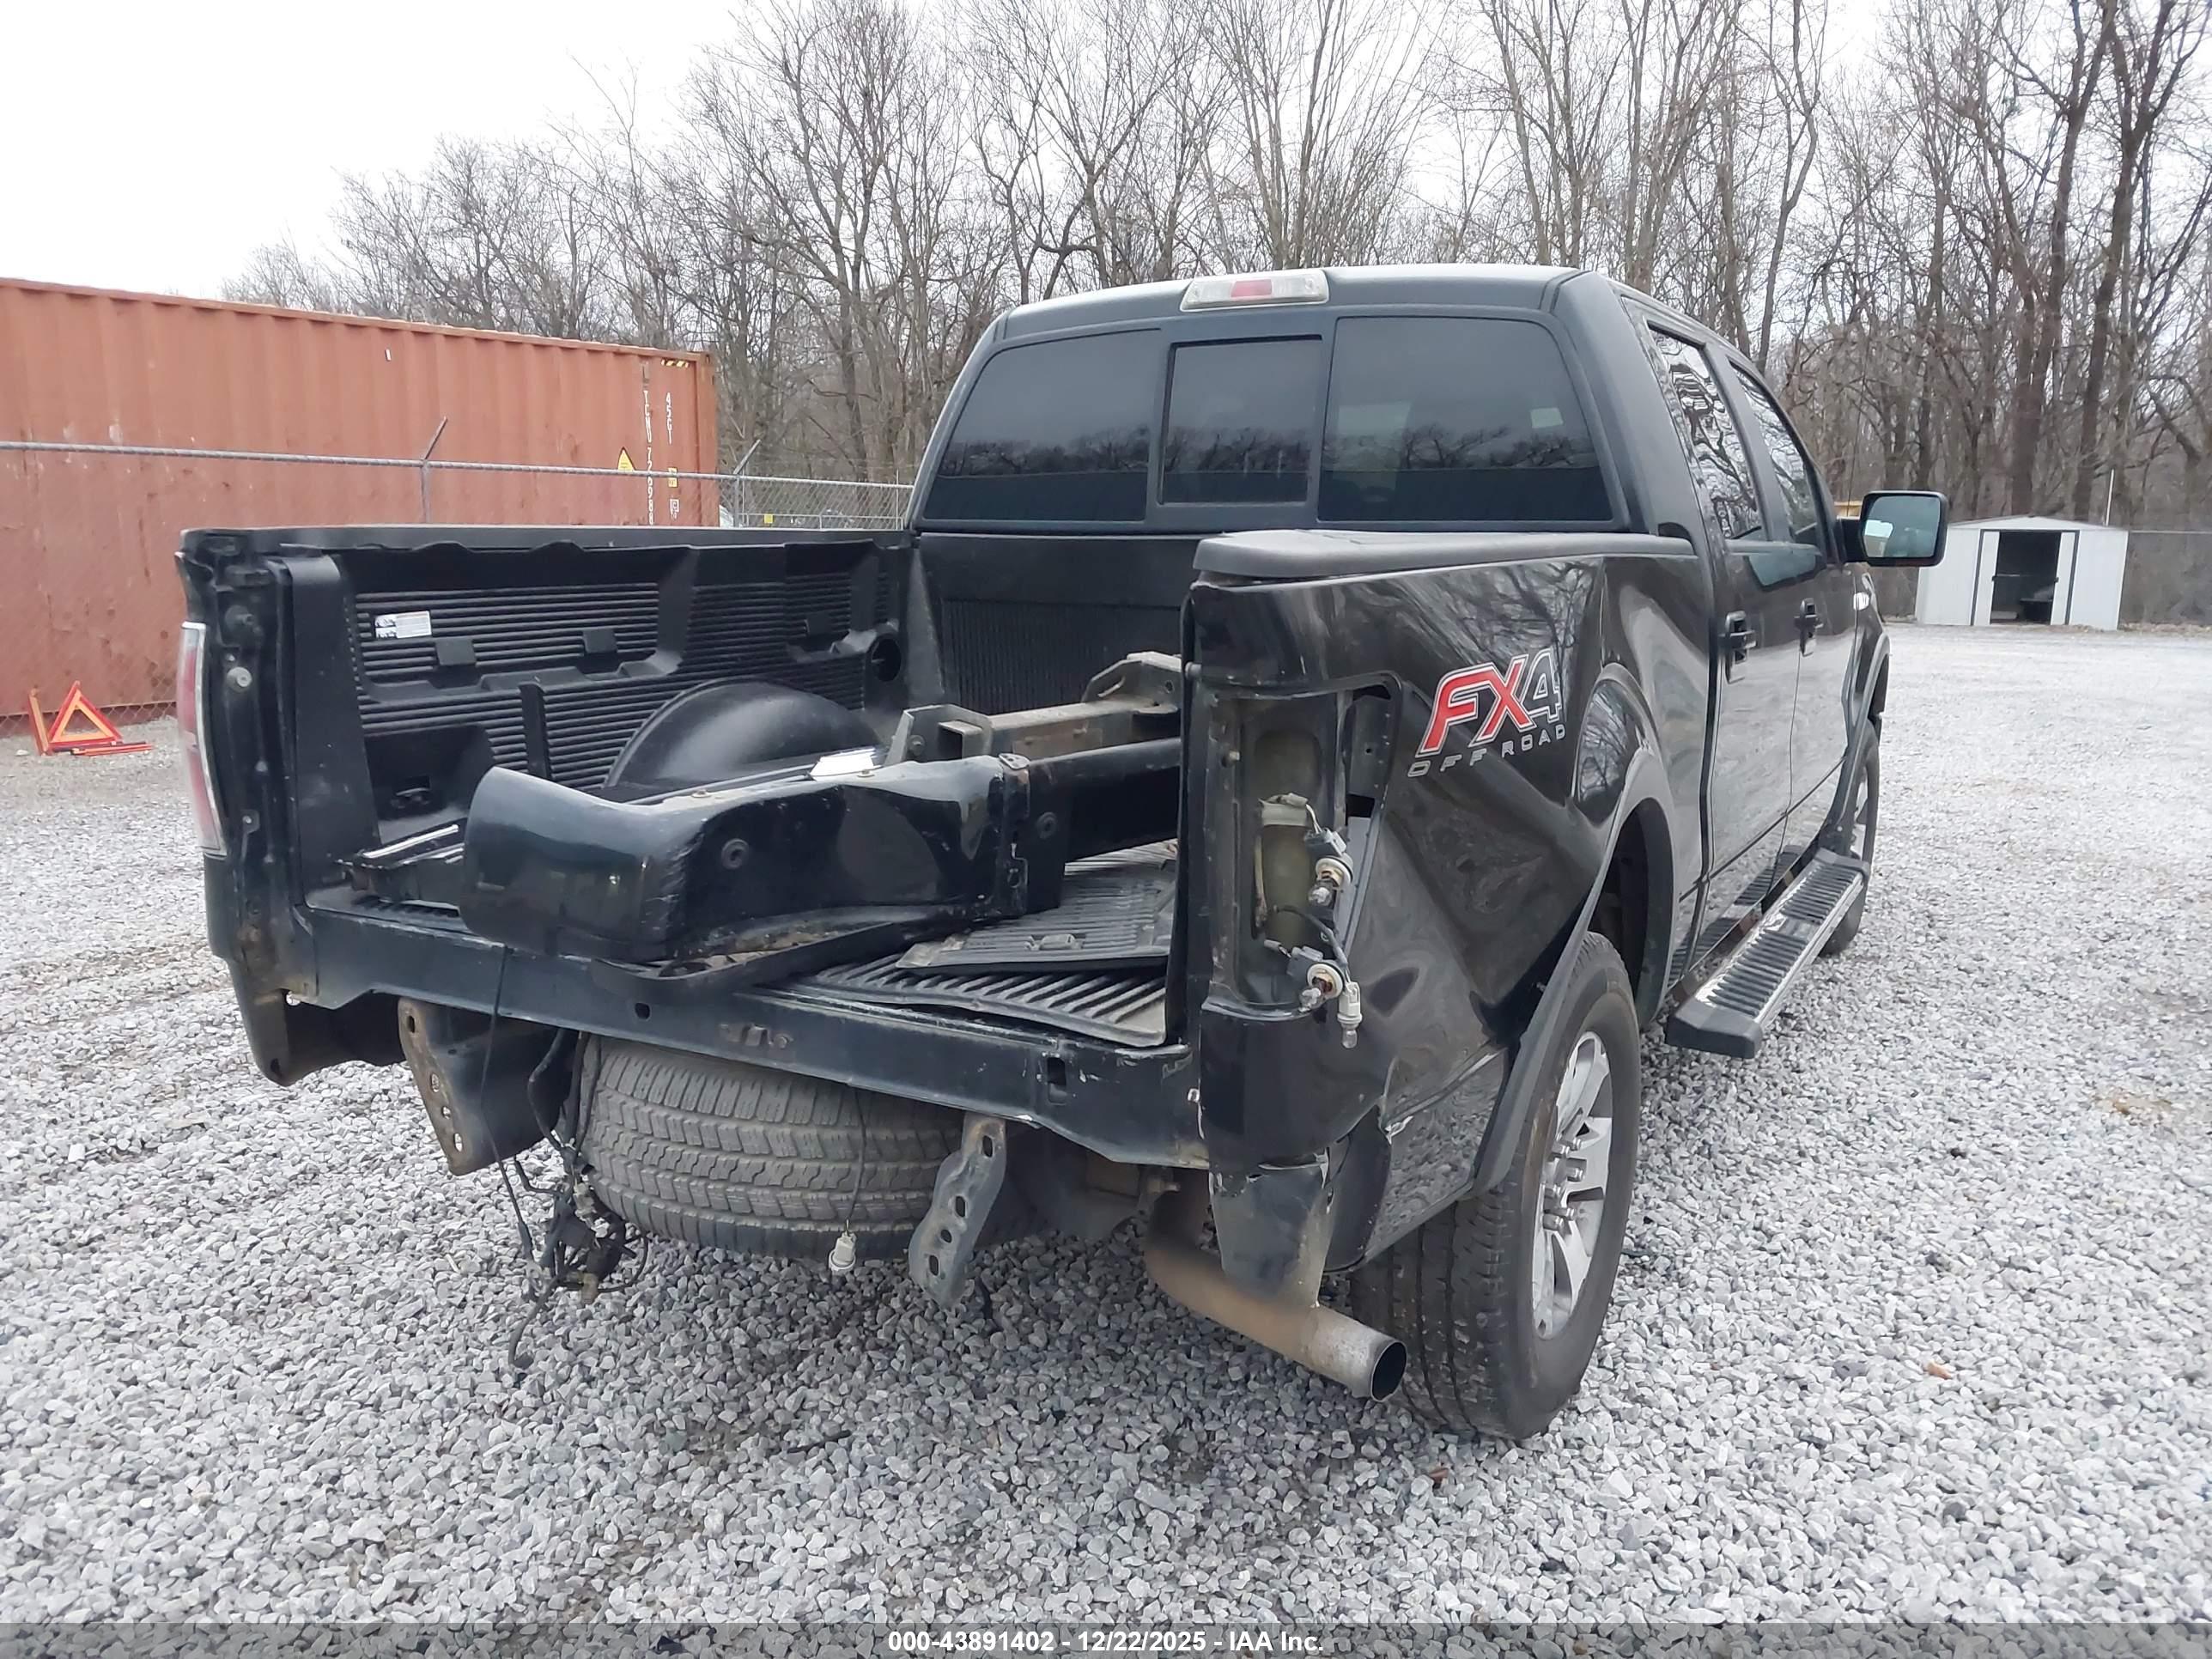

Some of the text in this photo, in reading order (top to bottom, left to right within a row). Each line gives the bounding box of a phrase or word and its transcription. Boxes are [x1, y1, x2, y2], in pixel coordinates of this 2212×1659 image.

[1414, 647, 1564, 758] FX4
[1407, 724, 1565, 778] OFF ROAD
